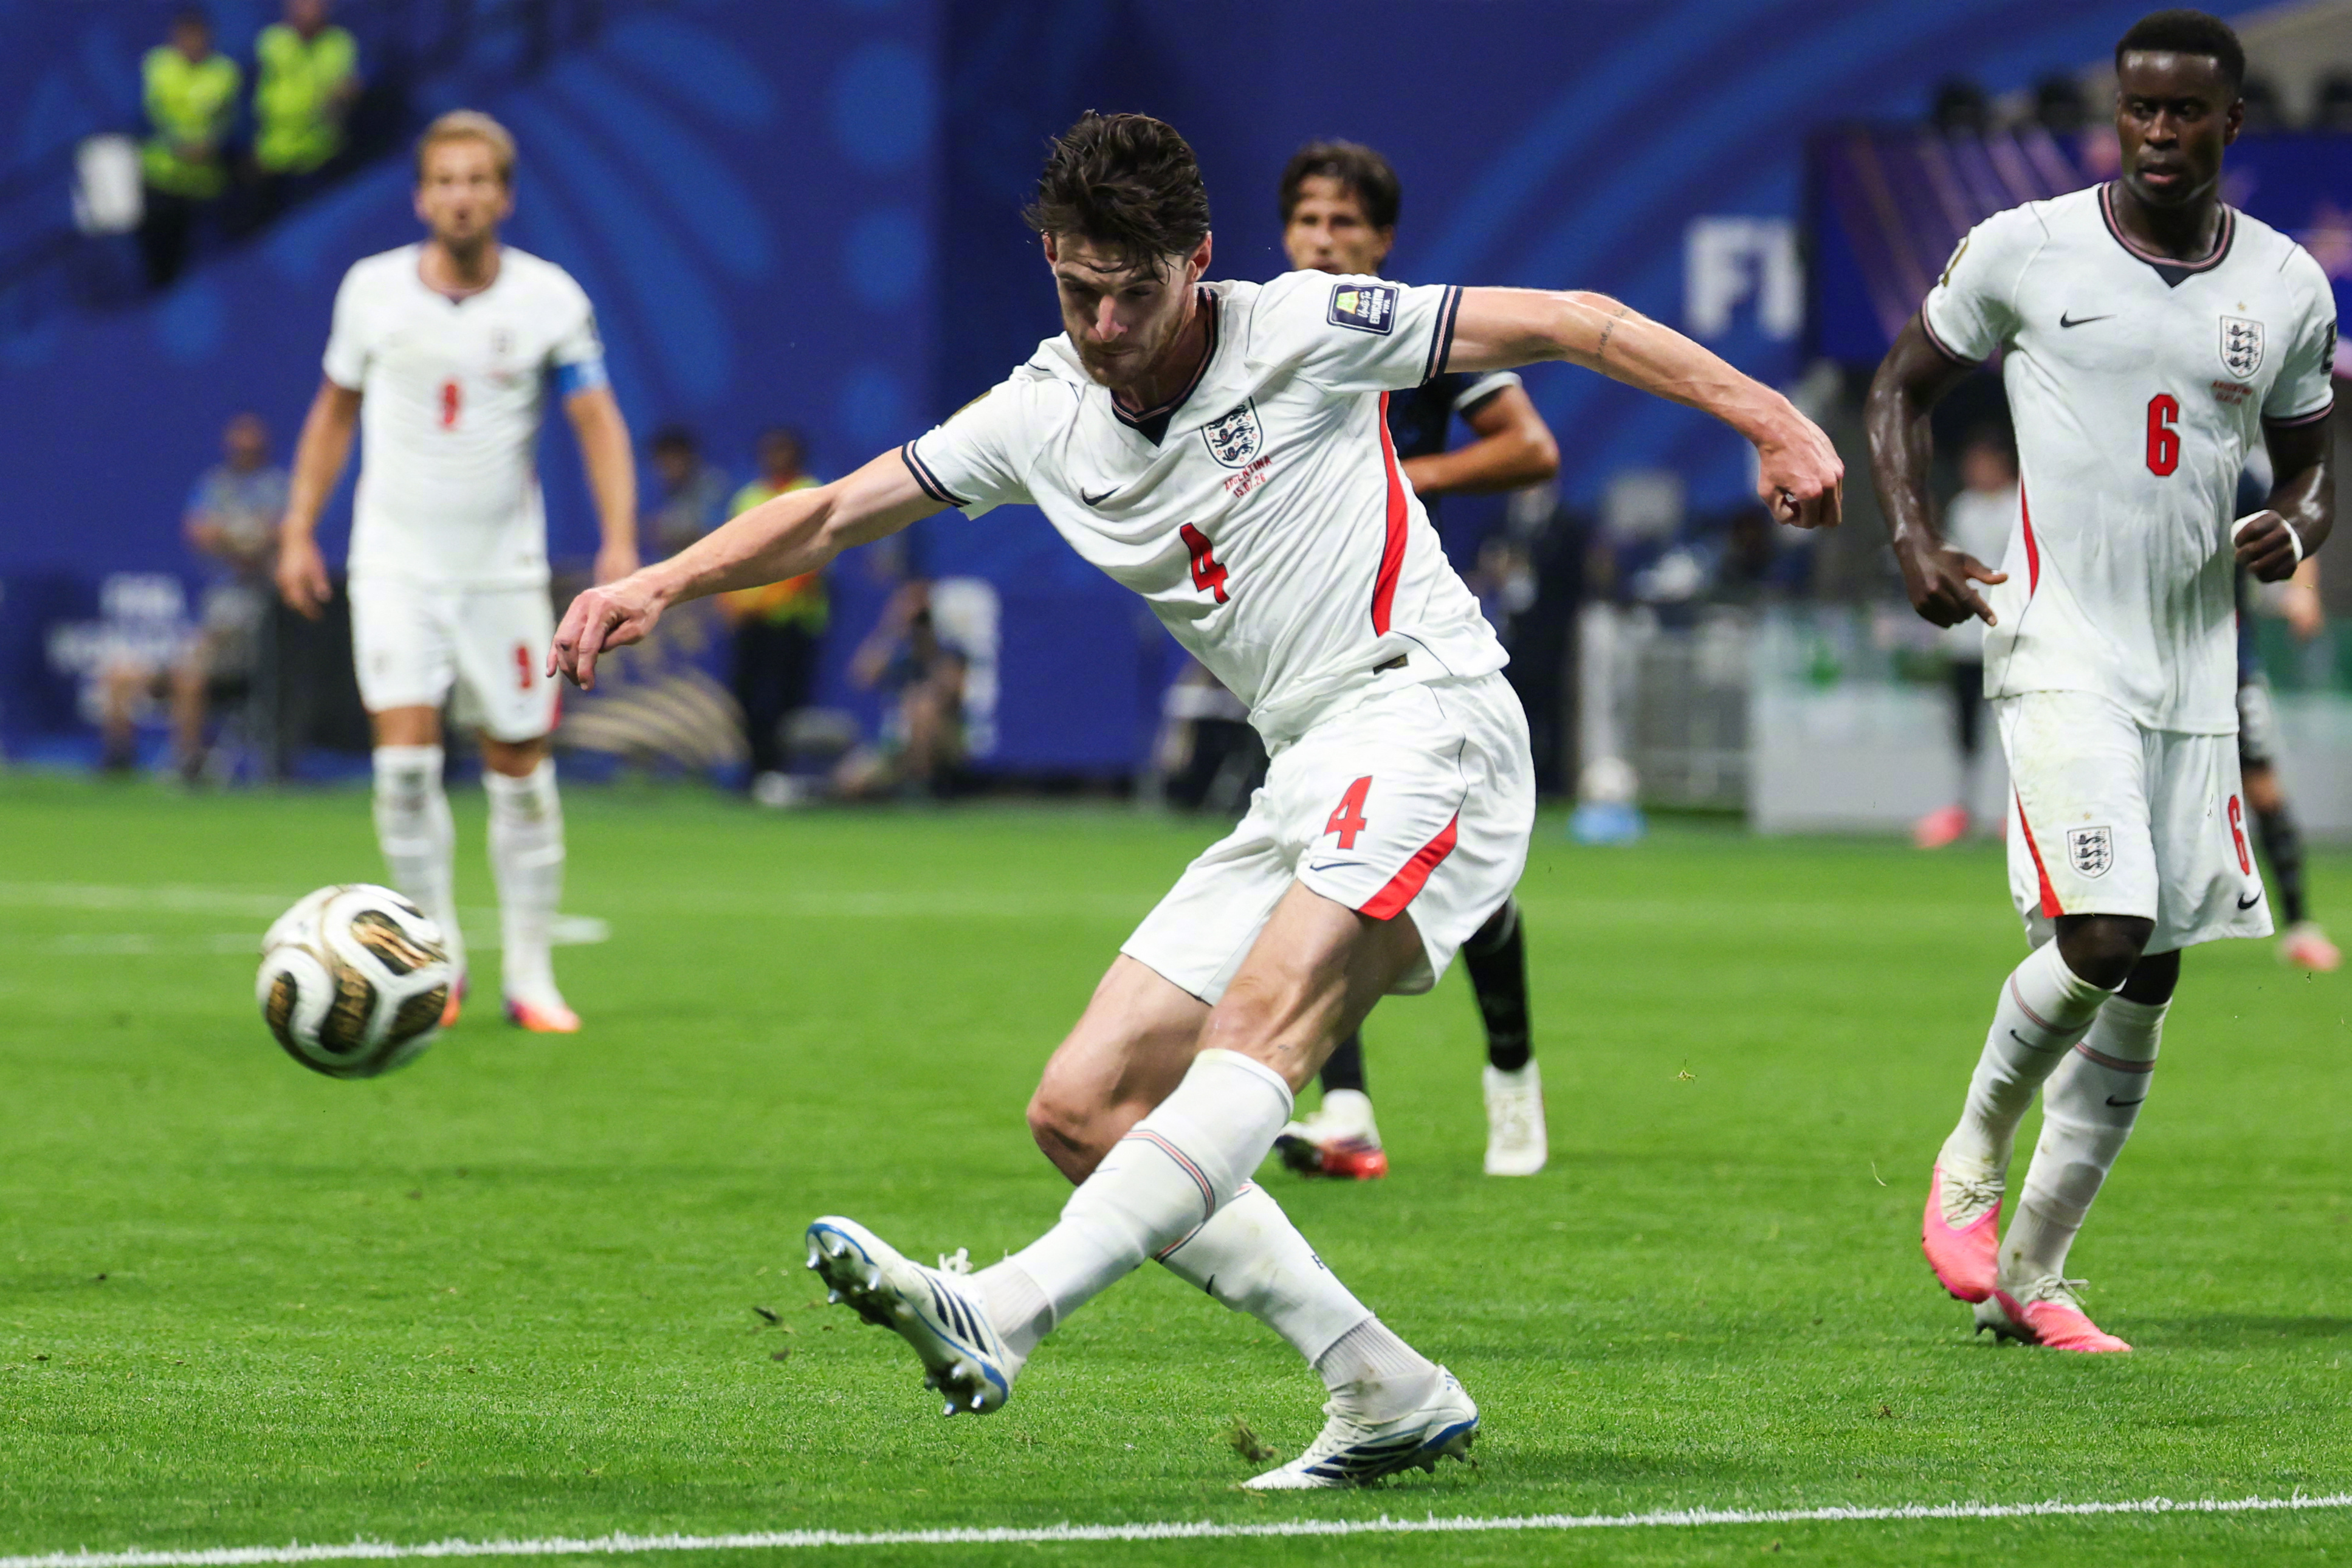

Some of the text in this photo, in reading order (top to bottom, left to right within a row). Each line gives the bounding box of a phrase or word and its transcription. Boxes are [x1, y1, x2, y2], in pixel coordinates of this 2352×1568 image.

[1382, 298, 1391, 314] FIFA
[2146, 393, 2181, 477] 6
[1180, 522, 1230, 604] 4
[1323, 775, 1373, 850] 4
[2227, 794, 2251, 876] 6
